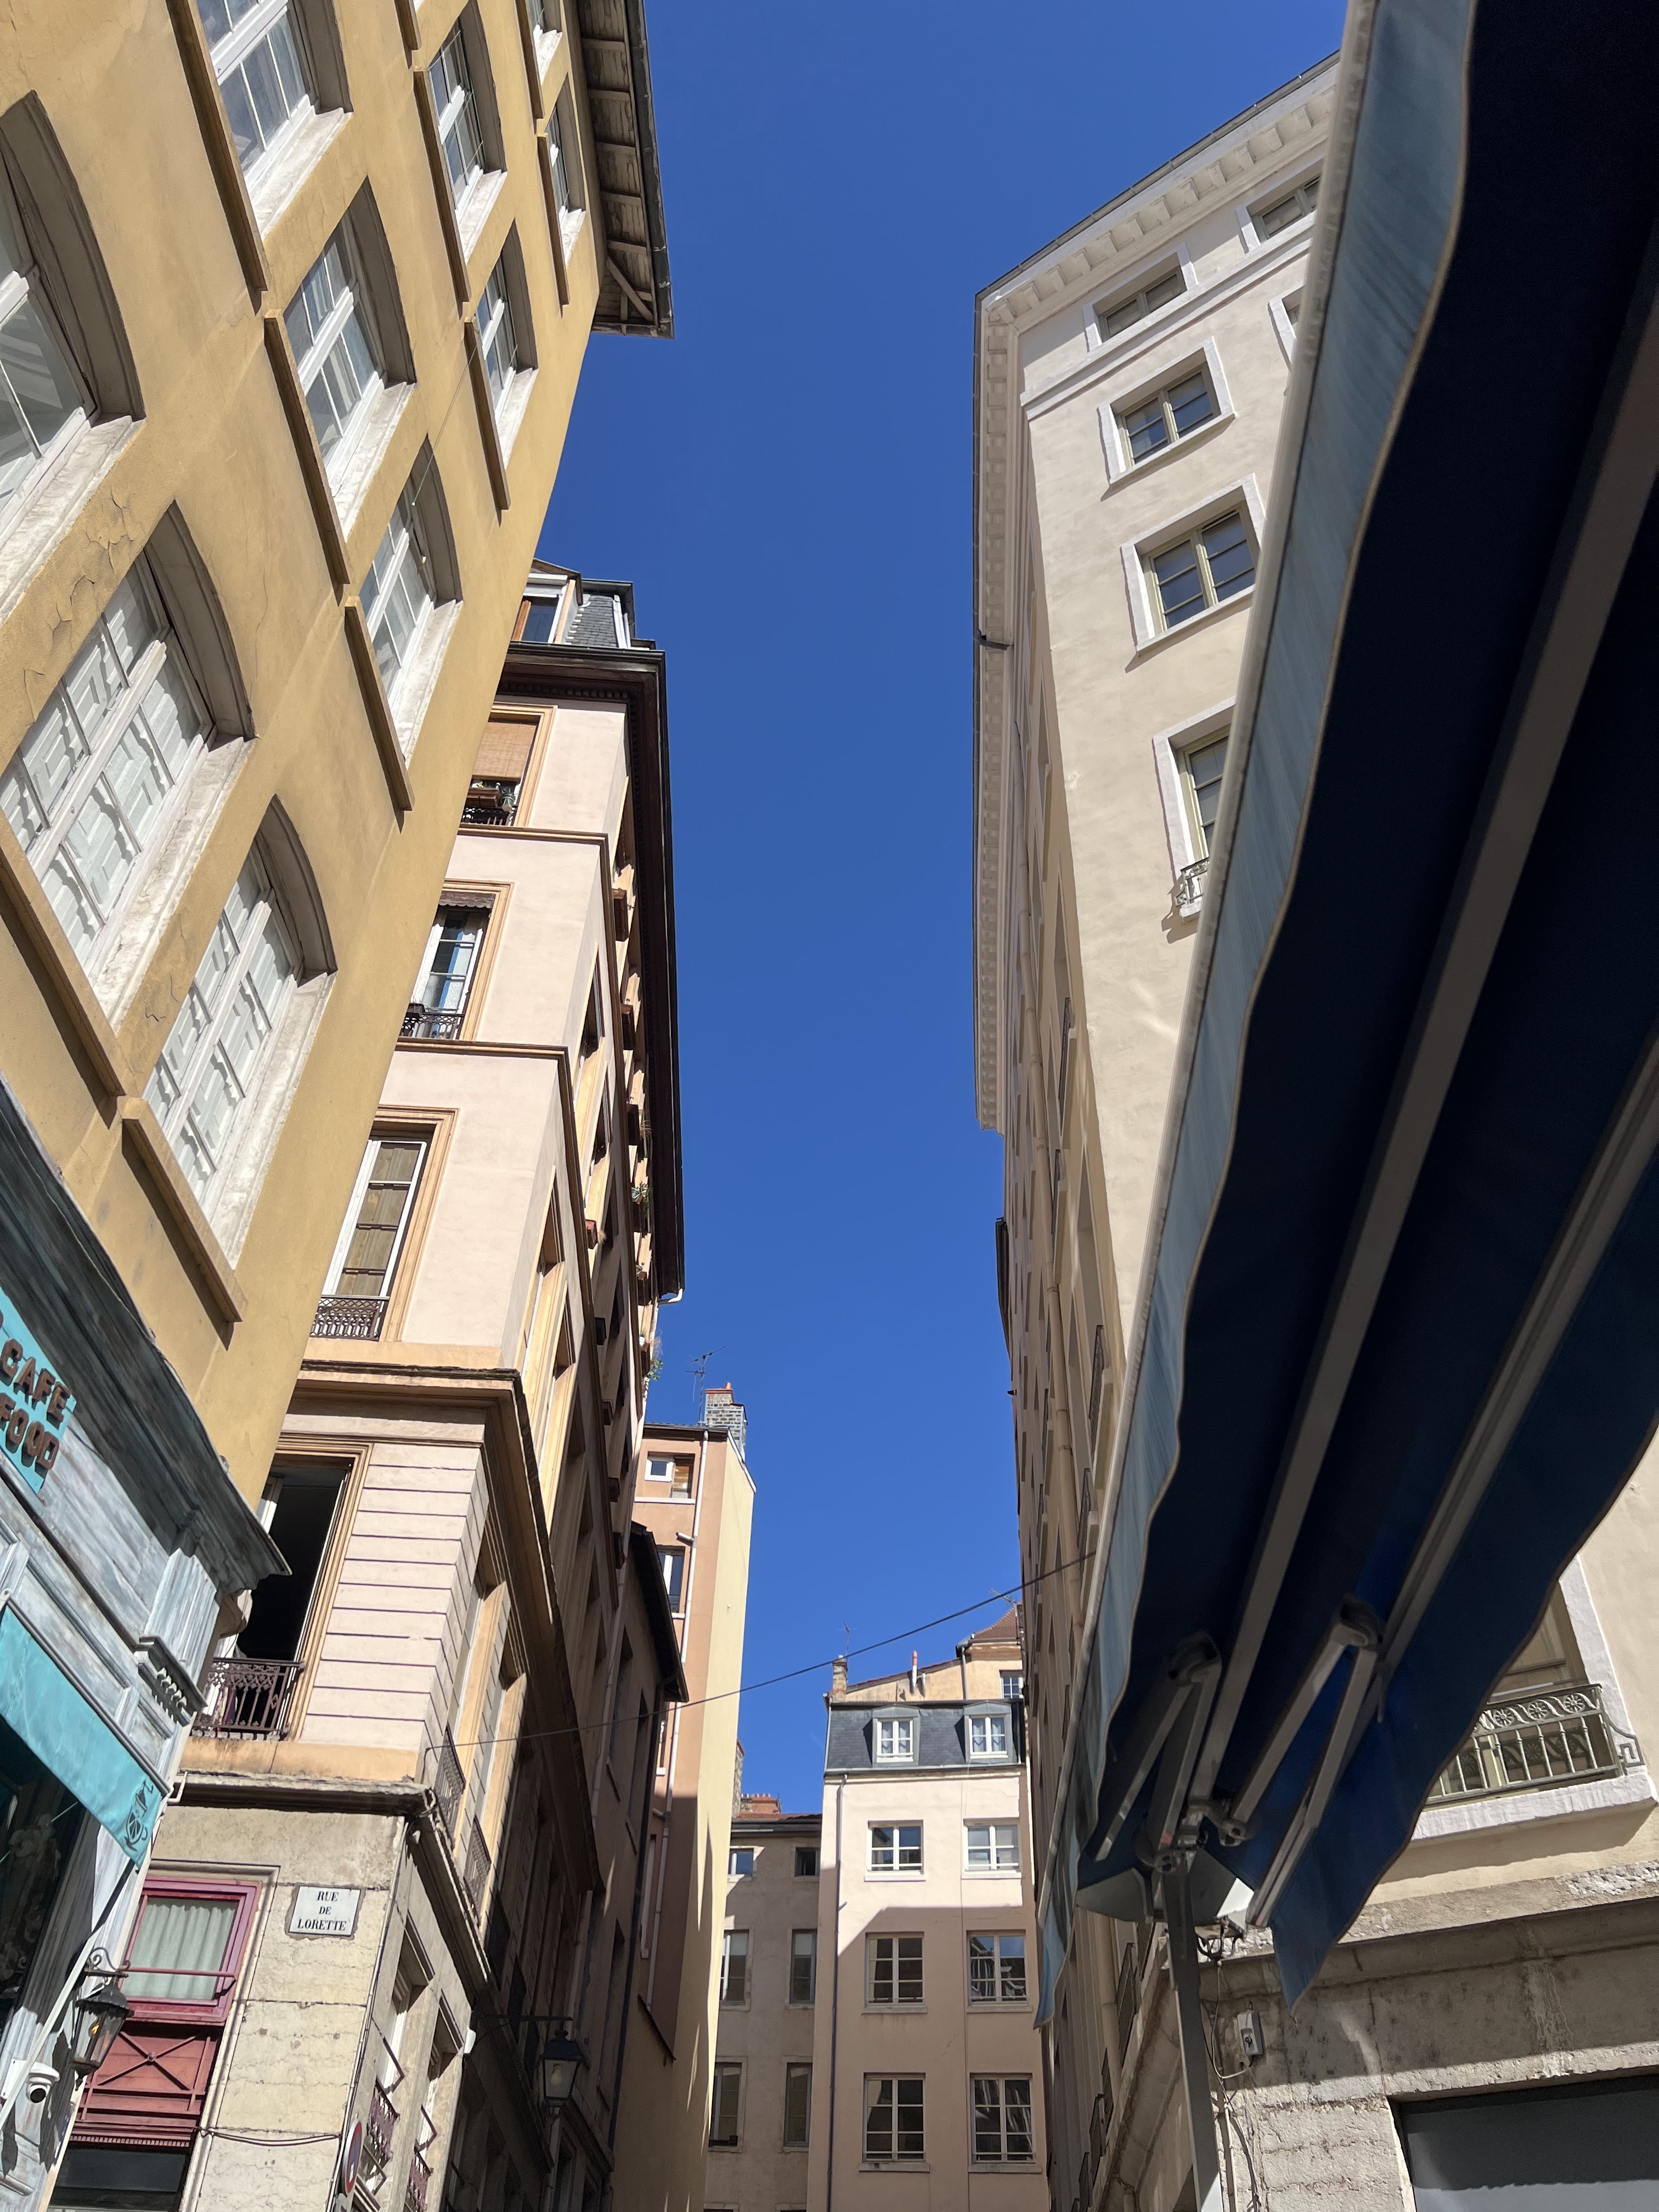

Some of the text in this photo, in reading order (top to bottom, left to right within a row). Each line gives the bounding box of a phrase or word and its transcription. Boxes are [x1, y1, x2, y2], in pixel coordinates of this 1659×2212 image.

[1, 1338, 72, 1427] CAFE
[317, 1891, 338, 1901] RUE
[297, 1918, 346, 1931] LORETTE
